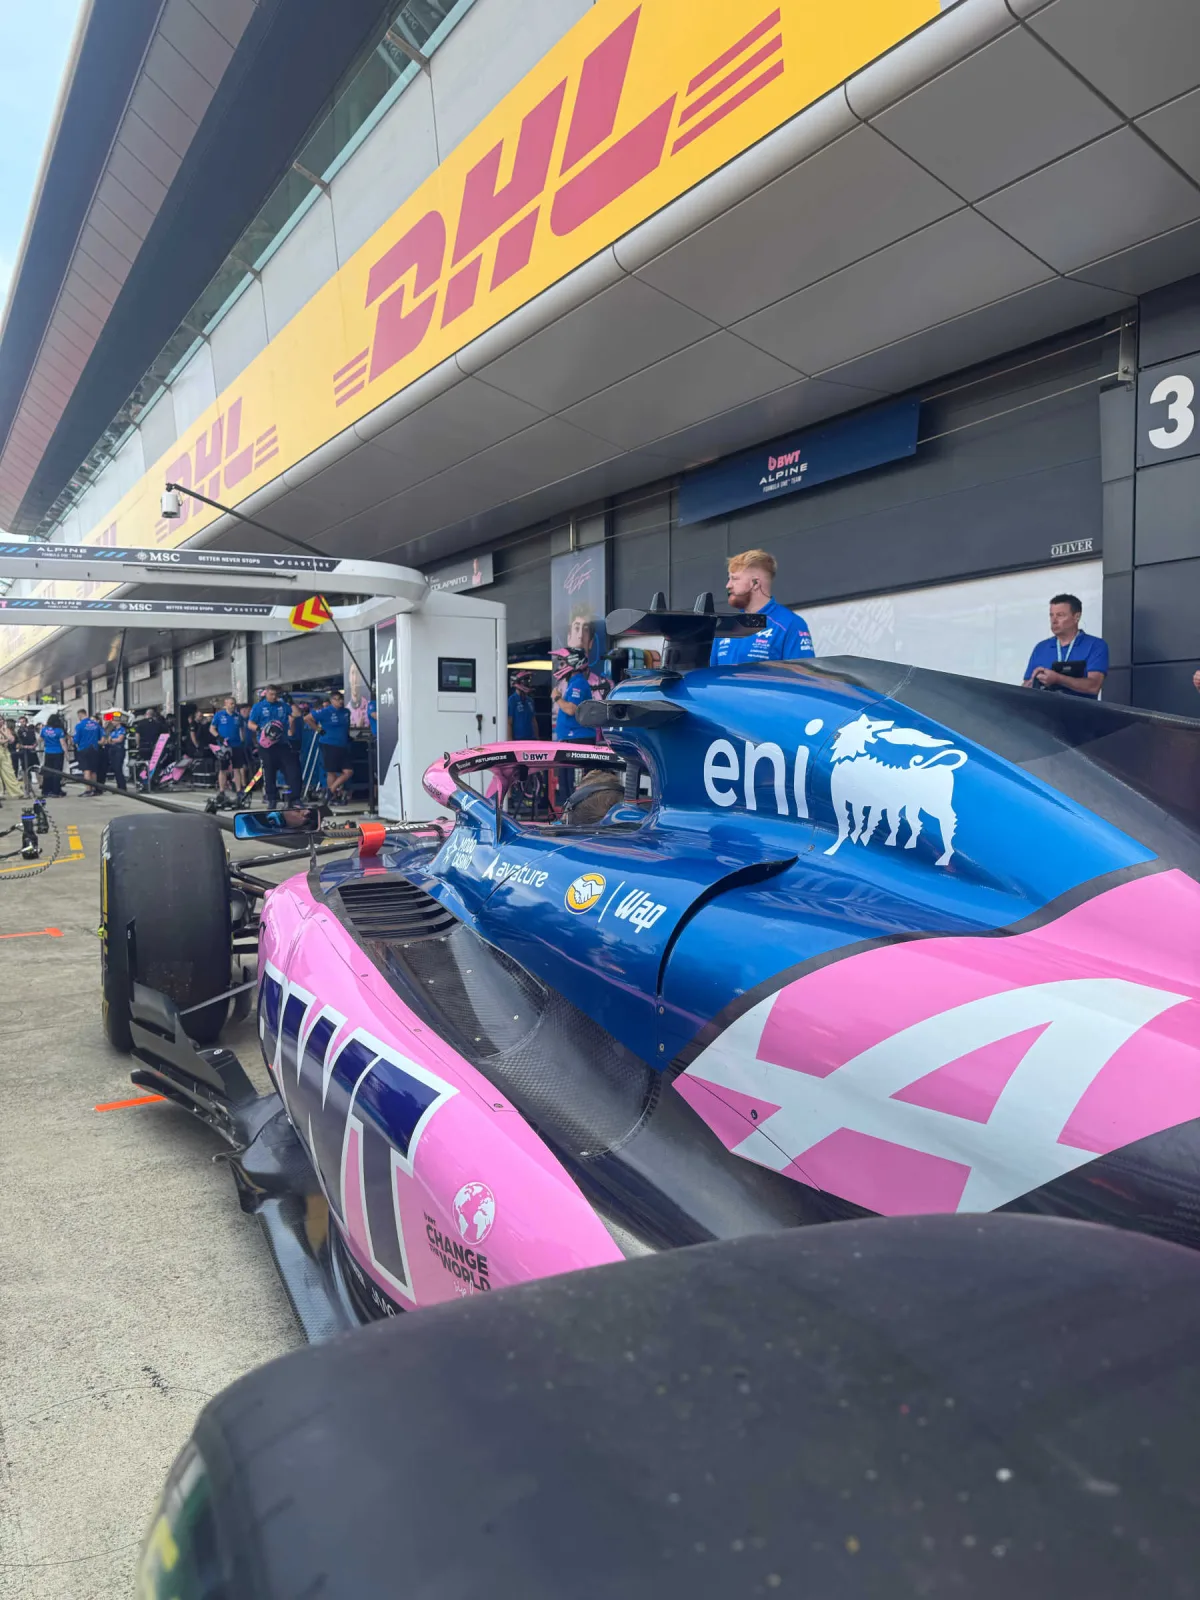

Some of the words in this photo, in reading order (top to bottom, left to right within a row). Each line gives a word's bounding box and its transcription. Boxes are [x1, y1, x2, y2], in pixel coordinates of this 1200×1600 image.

[365, 3, 678, 384] DHL
[1148, 374, 1195, 449] 3
[165, 396, 254, 535] DHL
[777, 449, 801, 468] BWT
[759, 462, 808, 485] ALPINE
[36, 546, 87, 554] ALPINE
[150, 552, 180, 562] MSC
[1051, 540, 1093, 557] OLIVER
[129, 603, 152, 611] MSC
[530, 753, 549, 761] BWT
[703, 718, 824, 819] eni
[496, 861, 549, 888] avature
[614, 889, 667, 934] Wap
[426, 1223, 489, 1277] CHANGE
[439, 1250, 492, 1292] WORLD
